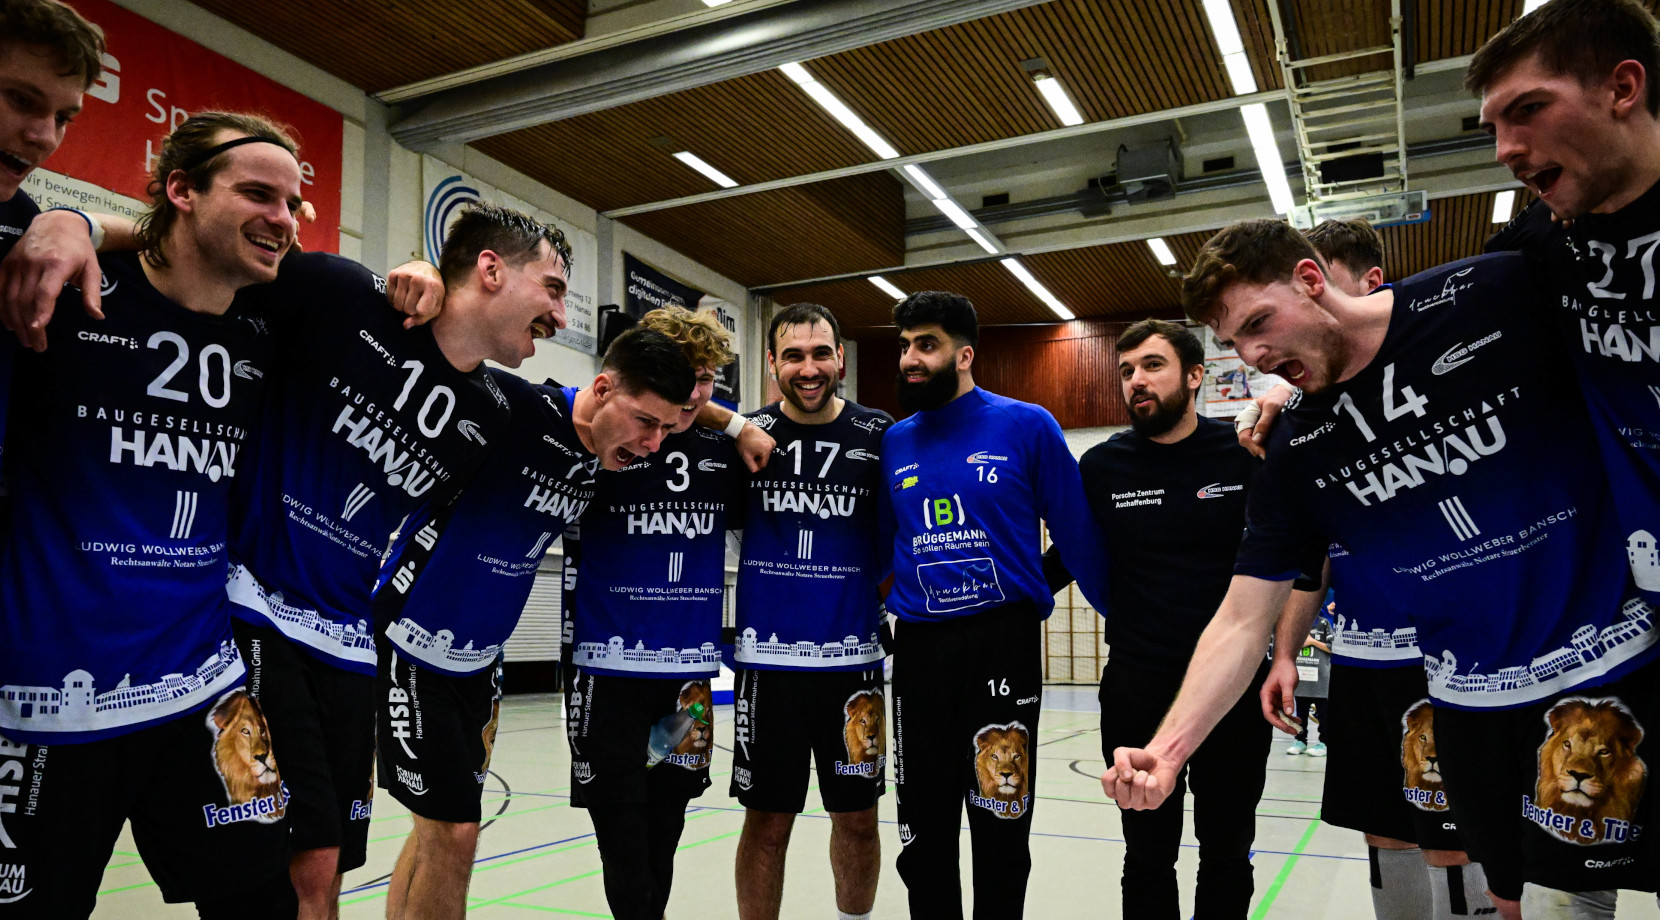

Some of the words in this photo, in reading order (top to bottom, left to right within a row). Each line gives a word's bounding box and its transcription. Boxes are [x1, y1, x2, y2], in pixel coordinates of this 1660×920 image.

[45, 179, 100, 204] bewegen
[1587, 229, 1660, 300] 27
[78, 331, 128, 347] CRAFT
[359, 330, 390, 360] CRAFT
[1580, 318, 1660, 363] HAN
[146, 331, 231, 409] 20
[393, 360, 456, 439] 10
[1332, 363, 1429, 443] 14
[329, 377, 450, 482] BAUGESELLSCHAFT
[1290, 425, 1325, 447] CRAFT
[1315, 387, 1520, 489] BAUGESELLSCHAFT
[332, 404, 436, 498] HANAU
[543, 434, 570, 454] CRAFT
[665, 451, 690, 492] 3
[787, 439, 841, 479] 17
[1345, 415, 1507, 506] HANAU
[976, 465, 998, 484] 16
[610, 501, 725, 513] BAUGESELLSCHAFT
[762, 490, 856, 519] HANAU
[1111, 491, 1136, 501] Porsche
[1136, 488, 1165, 498] Zentrum
[1115, 497, 1162, 509] Aschaffenburg
[627, 511, 715, 539] HANAU
[912, 529, 987, 547] BRÜGGEMANN
[1439, 535, 1515, 563] WOLLWEBER
[1519, 507, 1577, 540] BANSCH
[477, 553, 509, 568] LUDWIG
[912, 547, 921, 555] So
[922, 544, 943, 553] sollen
[944, 541, 972, 551] Räume
[974, 540, 990, 548] sein
[1473, 552, 1501, 566] Notare
[110, 556, 172, 568] Rechtsanwälte
[743, 559, 774, 568] LUDWIG
[776, 563, 830, 572] WOLLWEBER
[251, 639, 261, 667] GmbH
[988, 678, 1010, 697] 16
[1016, 696, 1033, 706] CRAFT
[388, 687, 412, 745] HSB
[568, 691, 582, 741] HSB
[736, 698, 750, 747] HSB
[663, 752, 699, 765] enster
[835, 760, 874, 776] Fenster
[24, 767, 43, 816] Hanauer
[203, 792, 276, 828] Fenster
[1580, 819, 1595, 839] &
[1584, 857, 1625, 869] CRAFT
